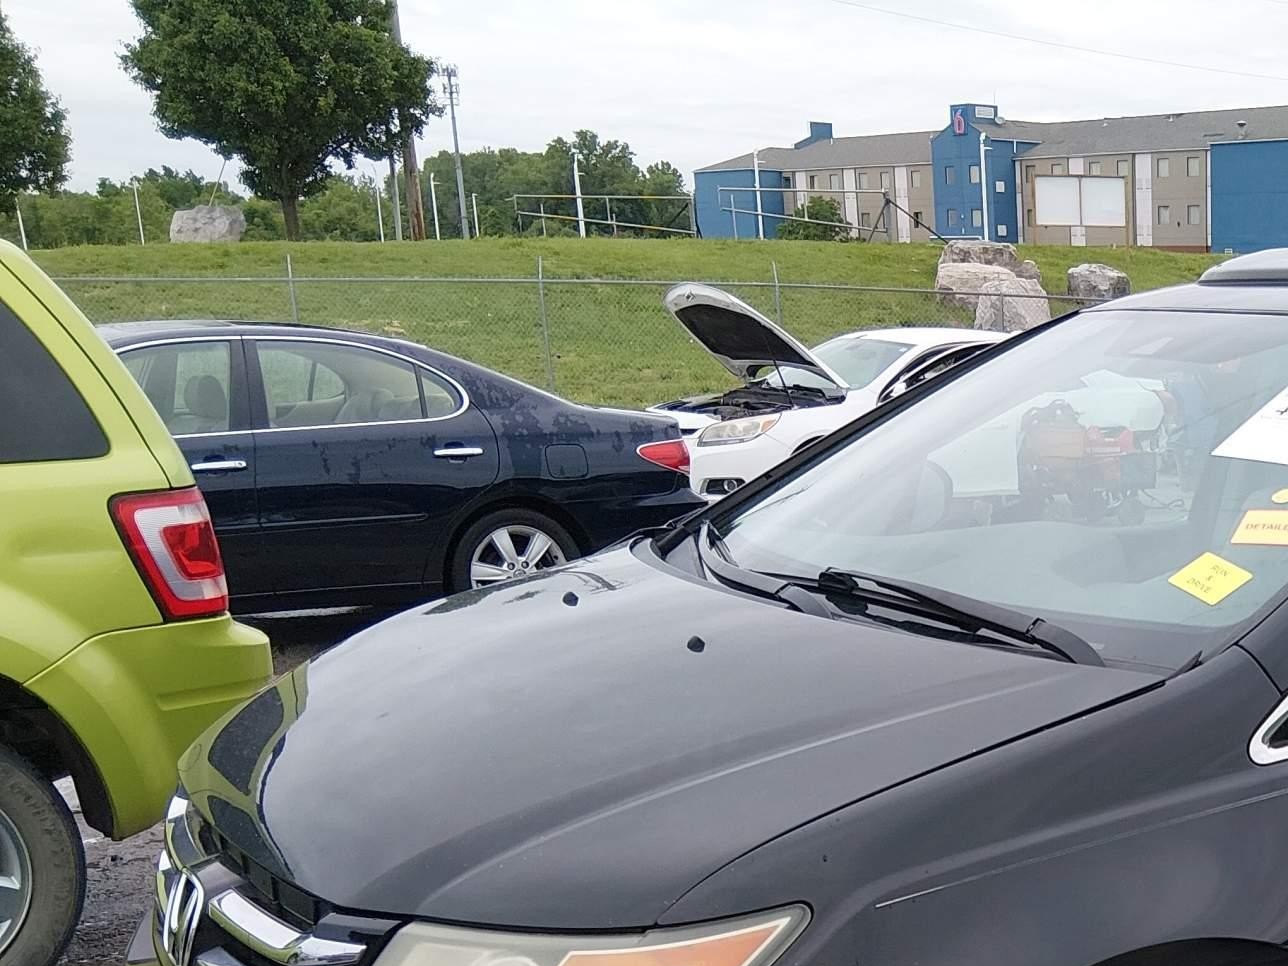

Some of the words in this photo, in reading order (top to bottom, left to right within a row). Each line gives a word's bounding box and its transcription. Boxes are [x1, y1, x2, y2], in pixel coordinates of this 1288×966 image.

[953, 108, 965, 134] 6
[1209, 563, 1231, 577] RUN
[1186, 576, 1213, 594] DRIVE
